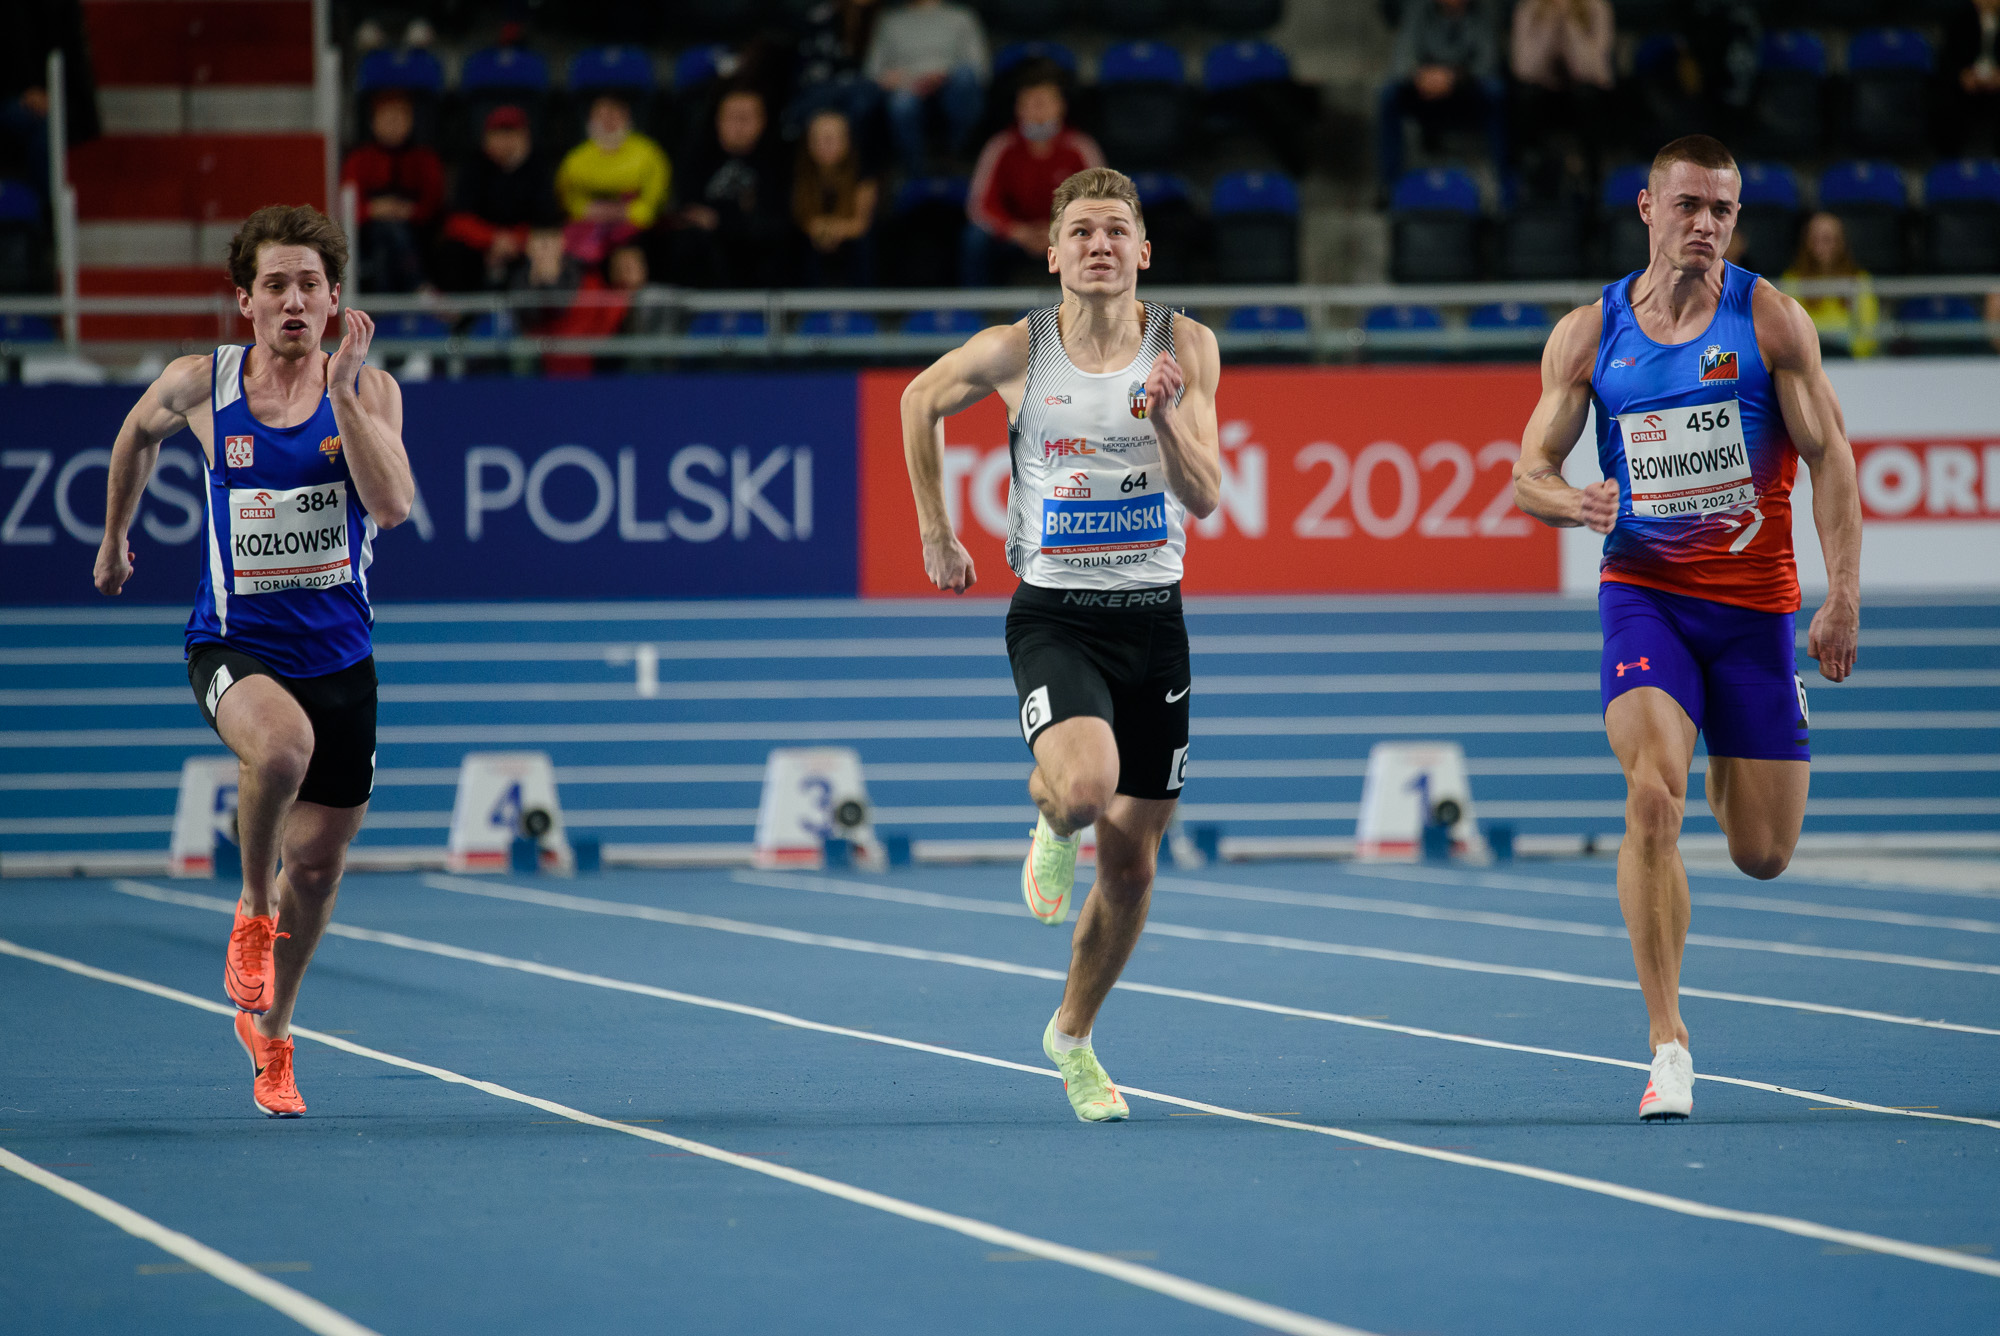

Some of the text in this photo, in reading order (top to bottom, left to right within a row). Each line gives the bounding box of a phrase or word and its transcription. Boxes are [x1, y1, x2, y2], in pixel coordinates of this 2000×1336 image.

[1686, 407, 1730, 433] 456
[1045, 437, 1096, 458] MKL
[1632, 431, 1665, 442] ORLEN
[1631, 442, 1745, 481] SŁOWIKOWSKI
[465, 443, 814, 543] POLSKI
[1055, 488, 1090, 498] ORLEN
[1120, 471, 1148, 494] 64
[1293, 440, 1533, 539] 2022
[1662, 490, 1685, 499] HALOWE
[1724, 480, 1743, 489] POLSKI
[295, 489, 339, 514] 384
[1651, 493, 1734, 515] TORUŃ 2022
[241, 510, 274, 519] ORLEN
[1045, 504, 1164, 536] BRZEZIŃSKI
[235, 524, 347, 557] KOZŁOWSKI
[327, 561, 344, 570] POLSKI
[1063, 553, 1147, 568] TORUŃ 2022
[253, 573, 336, 591] TORUŃ 2022
[1062, 589, 1171, 608] NIKE PRO
[1026, 696, 1041, 729] 6
[489, 781, 523, 838] 4
